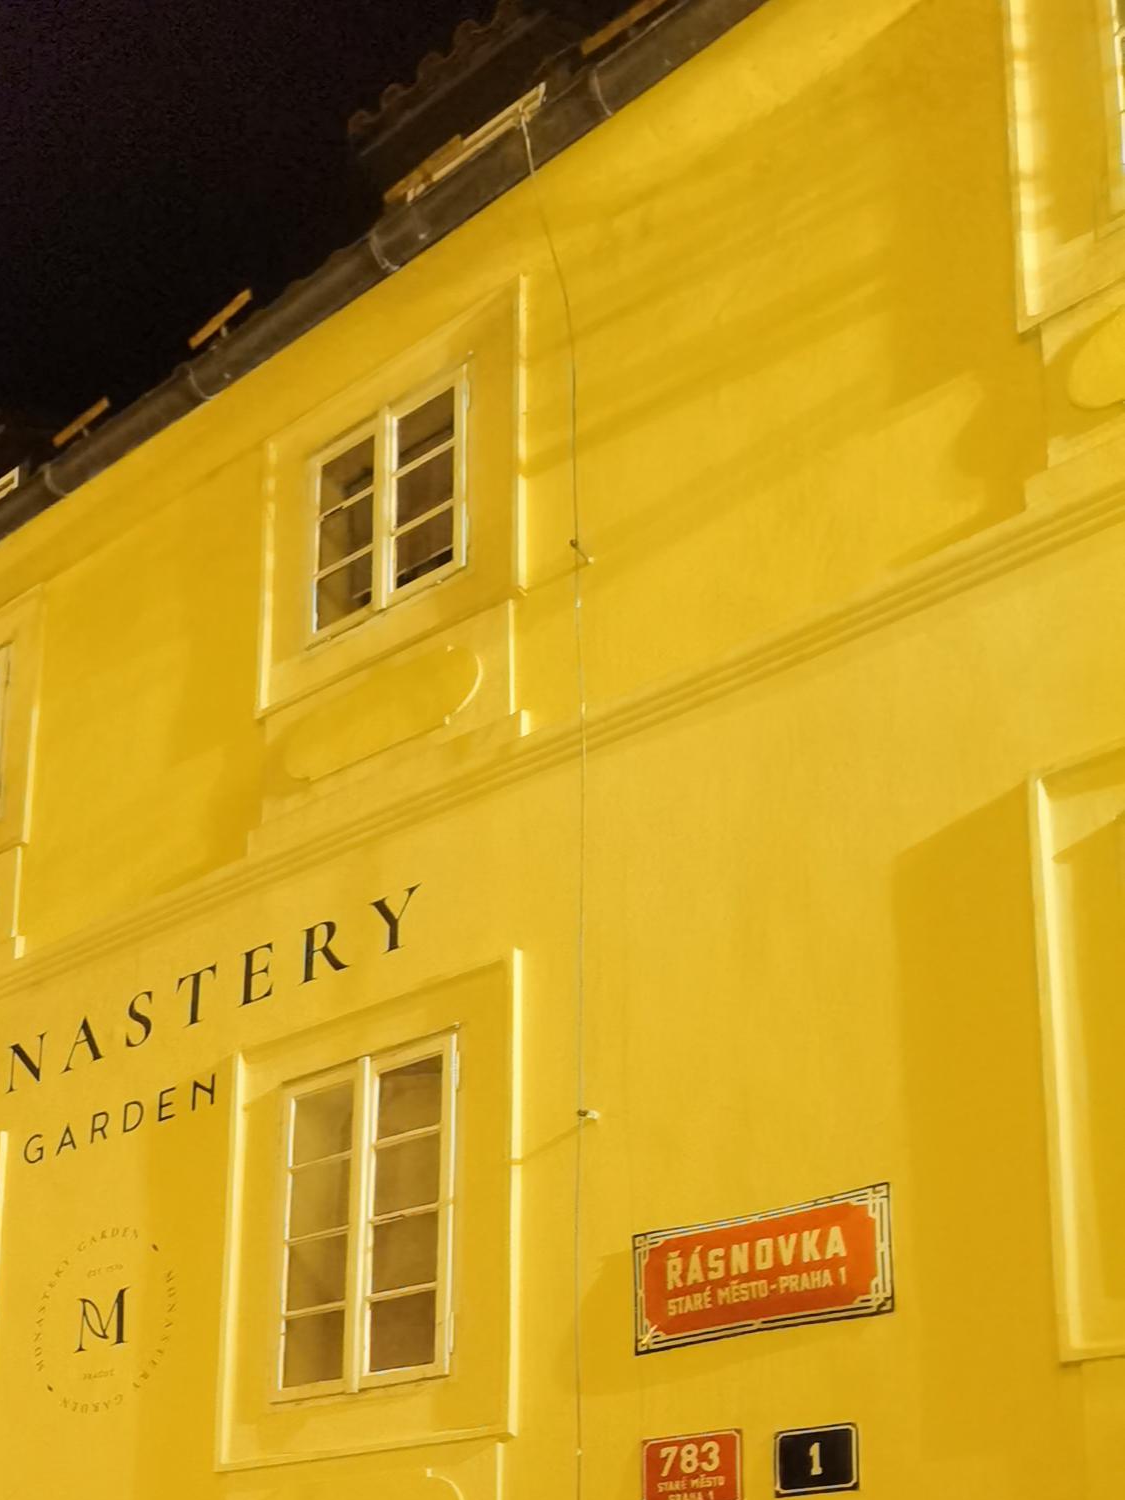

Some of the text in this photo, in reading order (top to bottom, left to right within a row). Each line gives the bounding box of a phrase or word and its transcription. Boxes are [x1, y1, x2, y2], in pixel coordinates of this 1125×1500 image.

[23, 1073, 217, 1165] GARDEN
[666, 1225, 848, 1290] ŘÁSNOVKA
[666, 1286, 714, 1316] STARÉ
[838, 1266, 848, 1286] 1
[659, 1441, 720, 1477] 783
[808, 1442, 823, 1476] 1
[708, 1490, 714, 1500] 1
